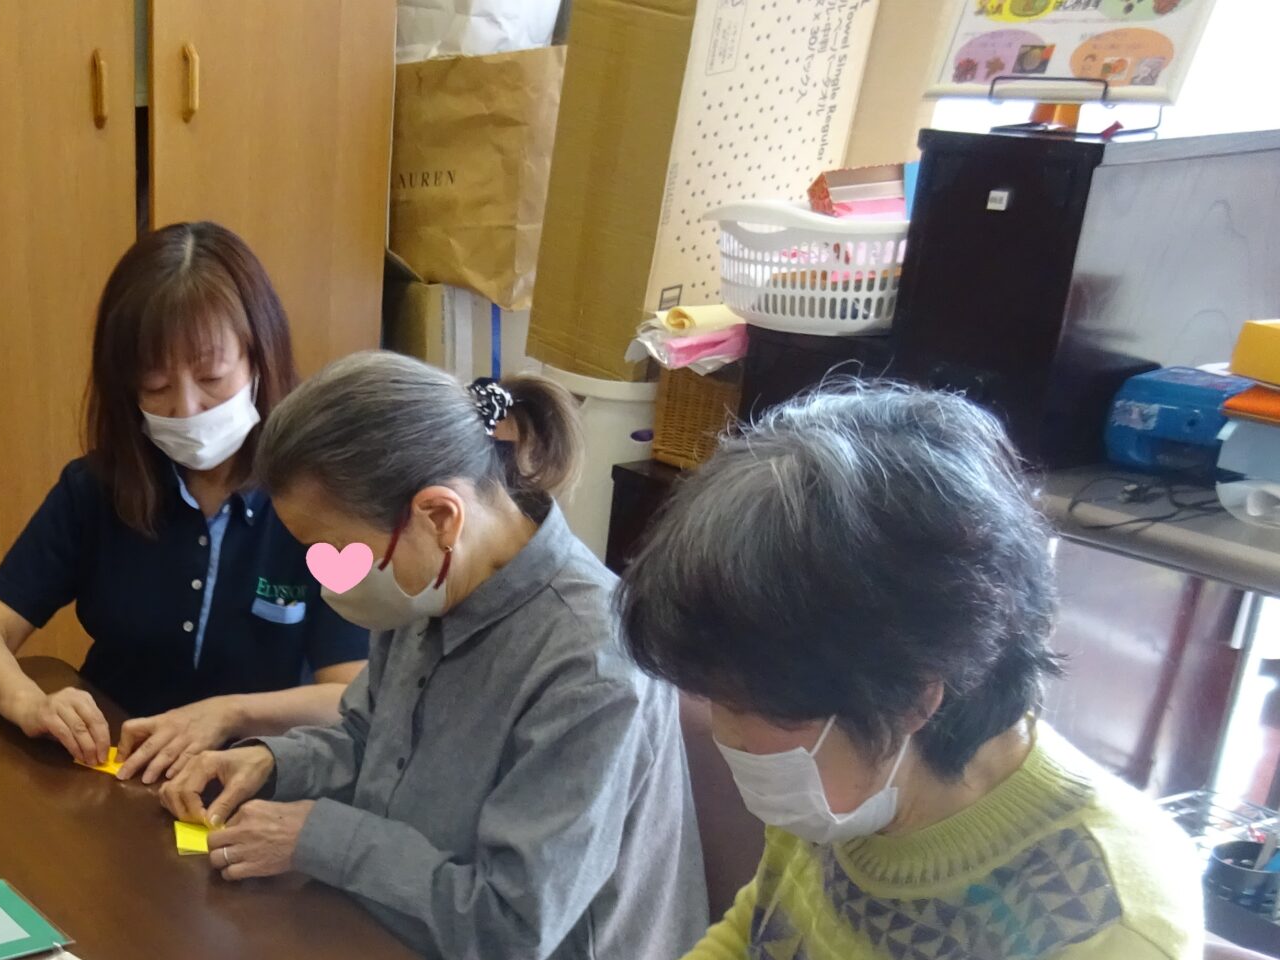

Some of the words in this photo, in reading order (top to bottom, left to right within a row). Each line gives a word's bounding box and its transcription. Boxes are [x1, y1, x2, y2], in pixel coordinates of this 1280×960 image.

[841, 3, 858, 49] Towel
[830, 55, 847, 100] Single
[818, 104, 837, 161] Regular
